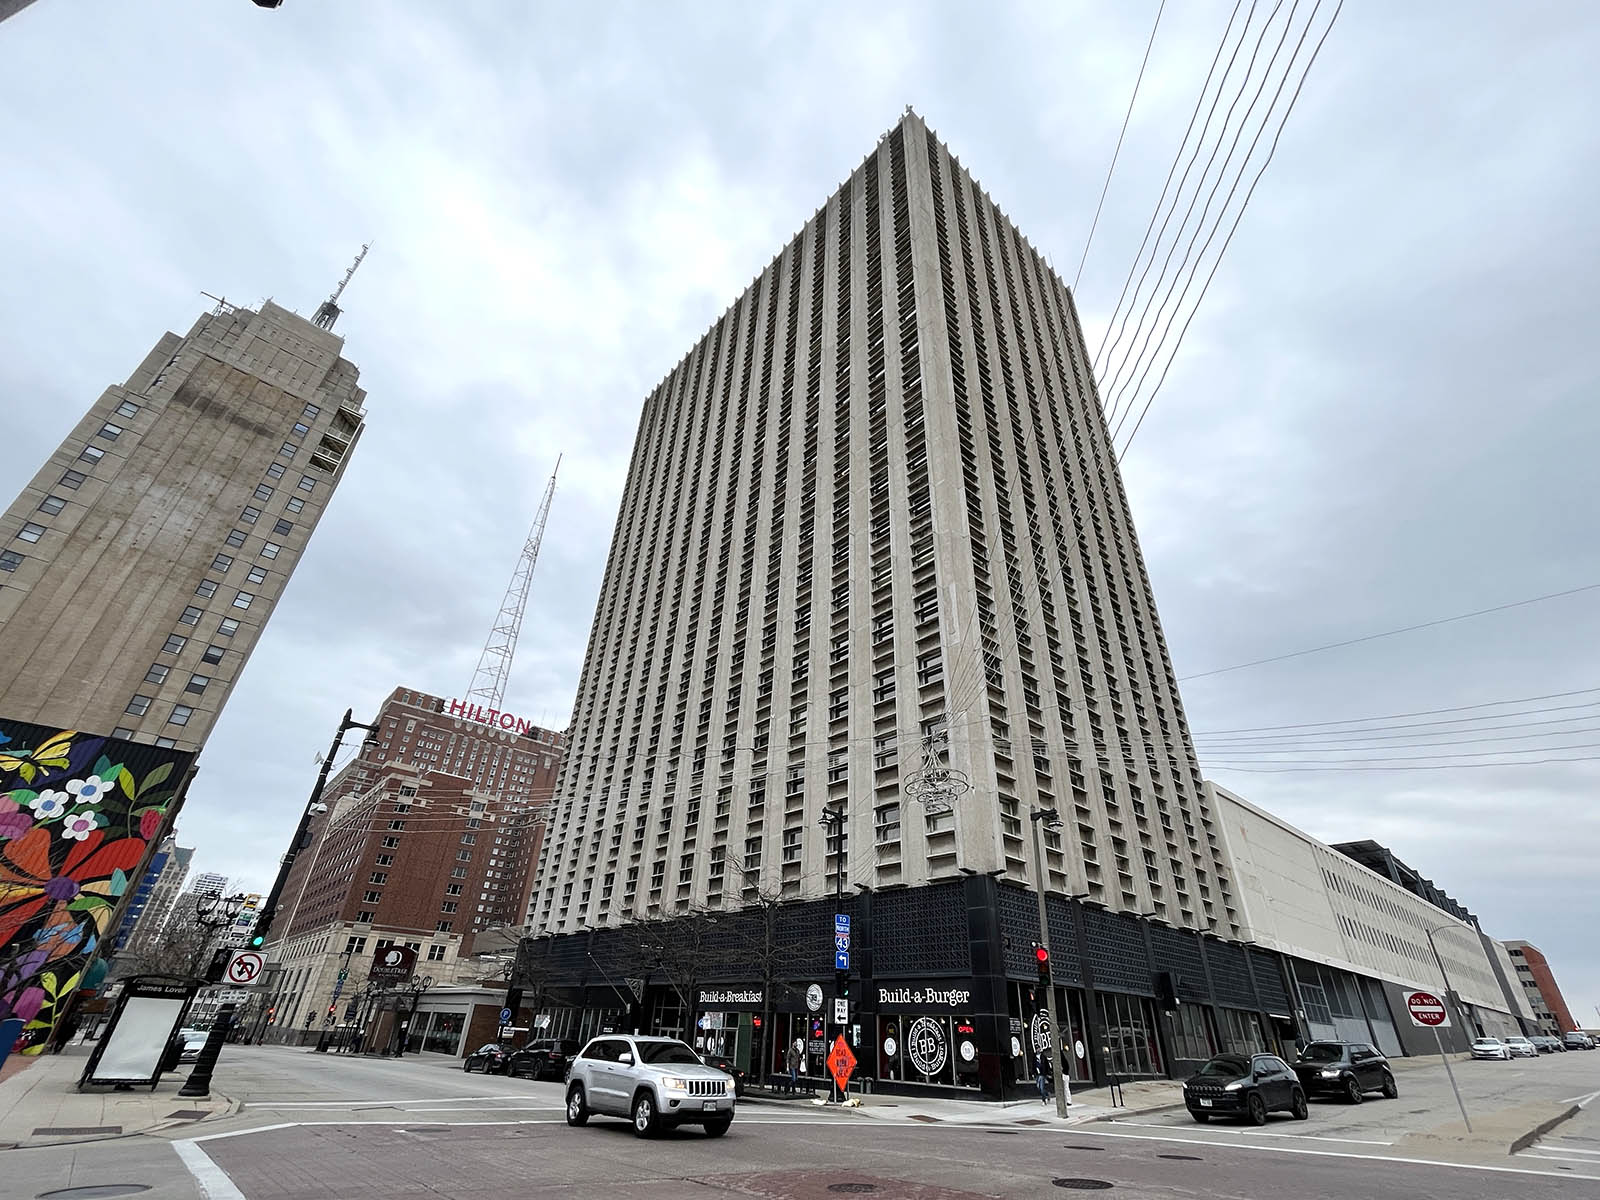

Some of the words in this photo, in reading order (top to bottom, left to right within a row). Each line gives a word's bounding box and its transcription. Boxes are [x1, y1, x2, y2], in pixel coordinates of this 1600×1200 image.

[449, 698, 532, 735] HILTON
[837, 937, 848, 949] 43
[137, 984, 163, 992] James
[164, 985, 188, 993] Lovell
[699, 990, 763, 1003] Build-a-Breakfast
[878, 988, 970, 1007] Build-a-Burger
[918, 1037, 936, 1055] BB
